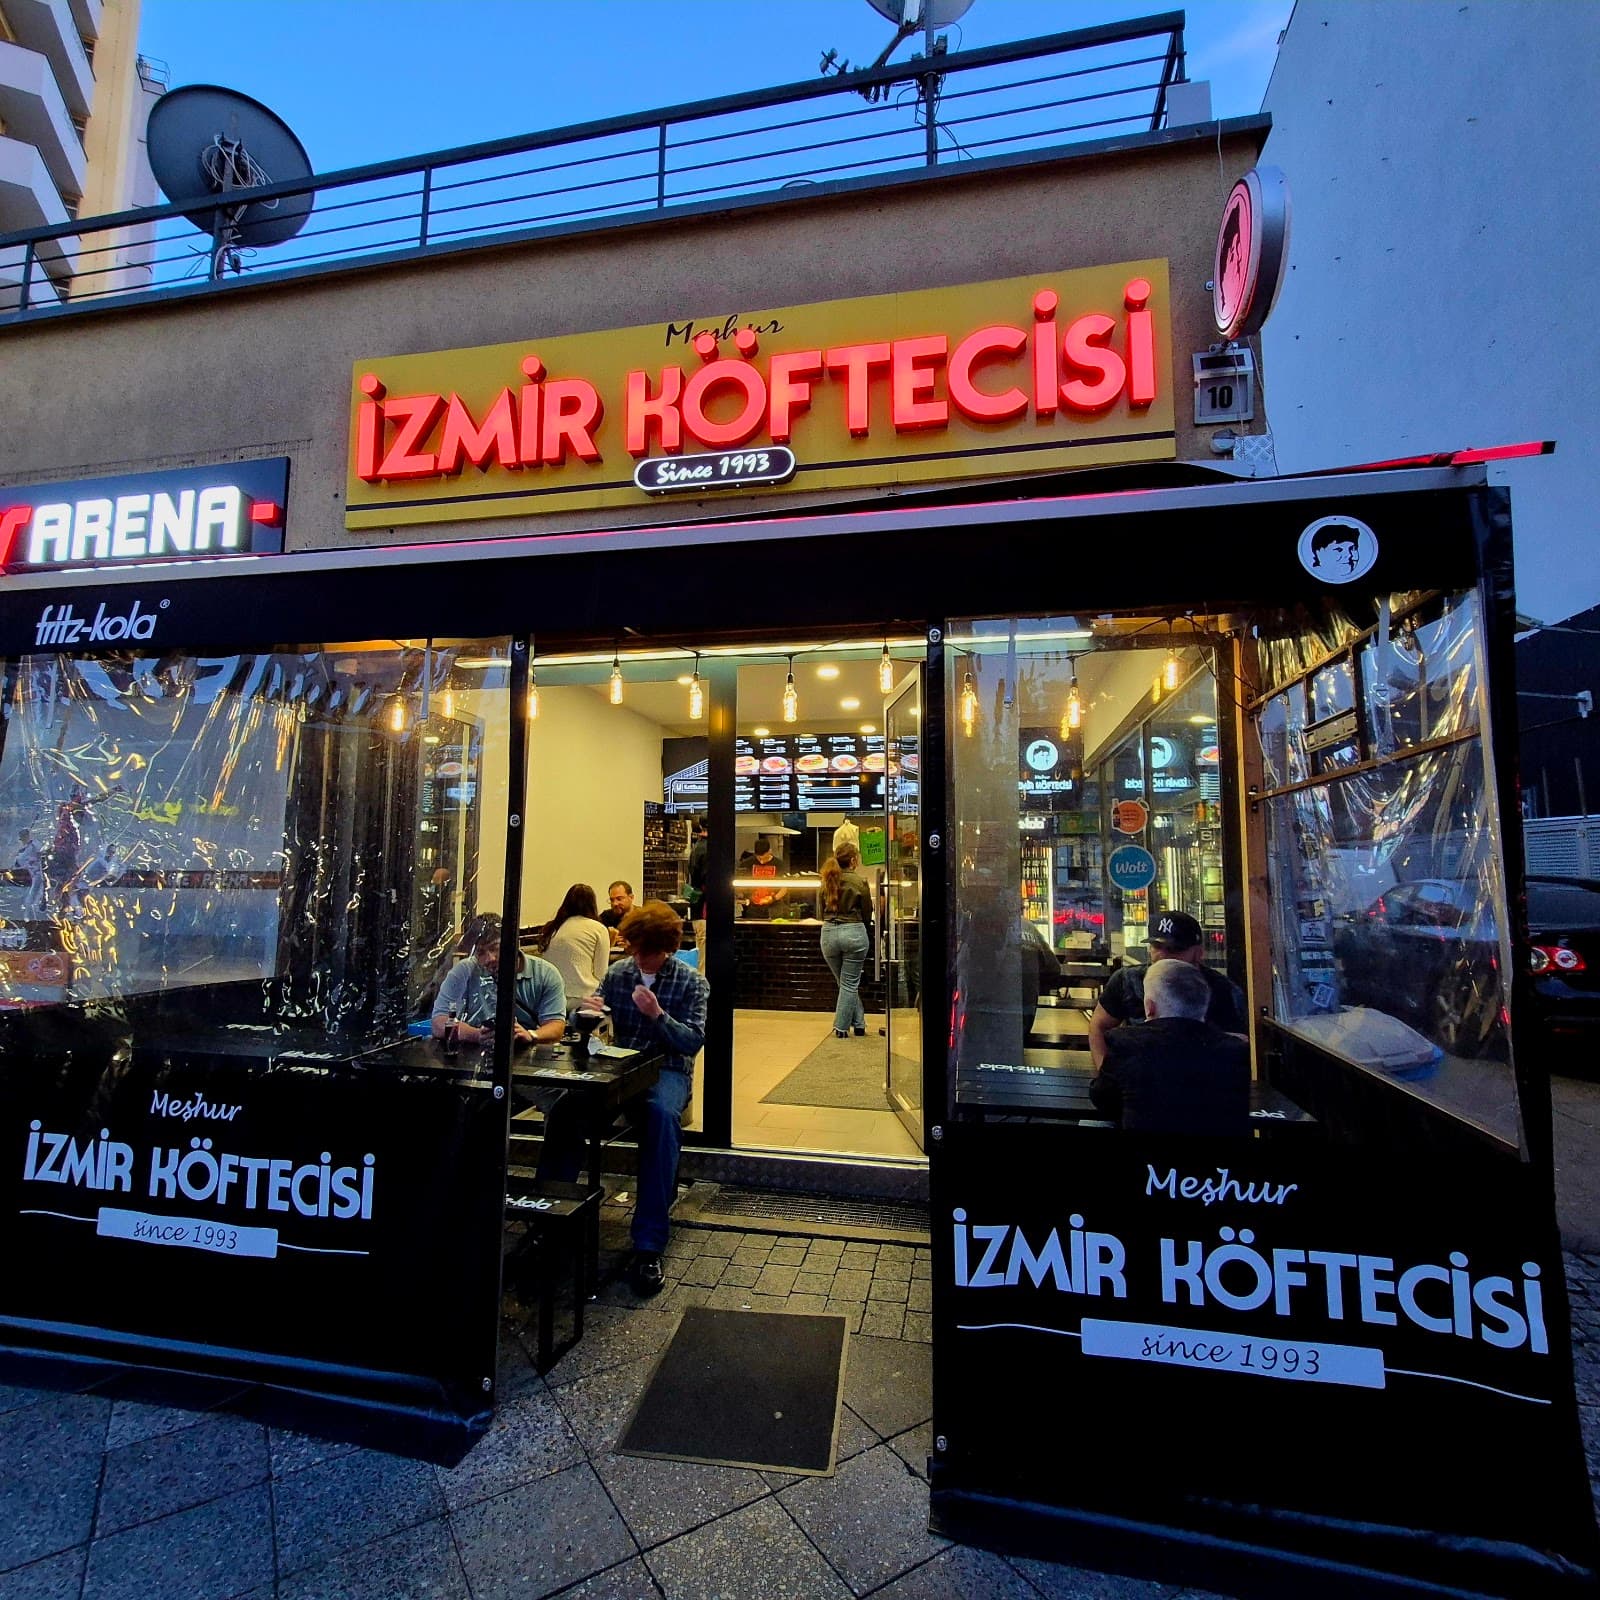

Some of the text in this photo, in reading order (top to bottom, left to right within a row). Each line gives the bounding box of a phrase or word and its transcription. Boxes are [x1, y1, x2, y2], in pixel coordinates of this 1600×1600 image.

[357, 279, 1156, 481] İZMİR KÖFTECİSİ
[1208, 385, 1233, 409] 10
[656, 453, 770, 484] Since 1993
[28, 485, 241, 564] ARENA
[1115, 861, 1149, 874] Wolt
[150, 1089, 242, 1122] Meşhur
[23, 1119, 376, 1220] İZMİR KÖFTECİSİ
[1146, 1164, 1297, 1208] Meşhur
[133, 1219, 238, 1250] since 1993
[953, 1207, 1549, 1354] İZMİR KÖFTECİSİ
[1140, 1332, 1321, 1376] since 1993
